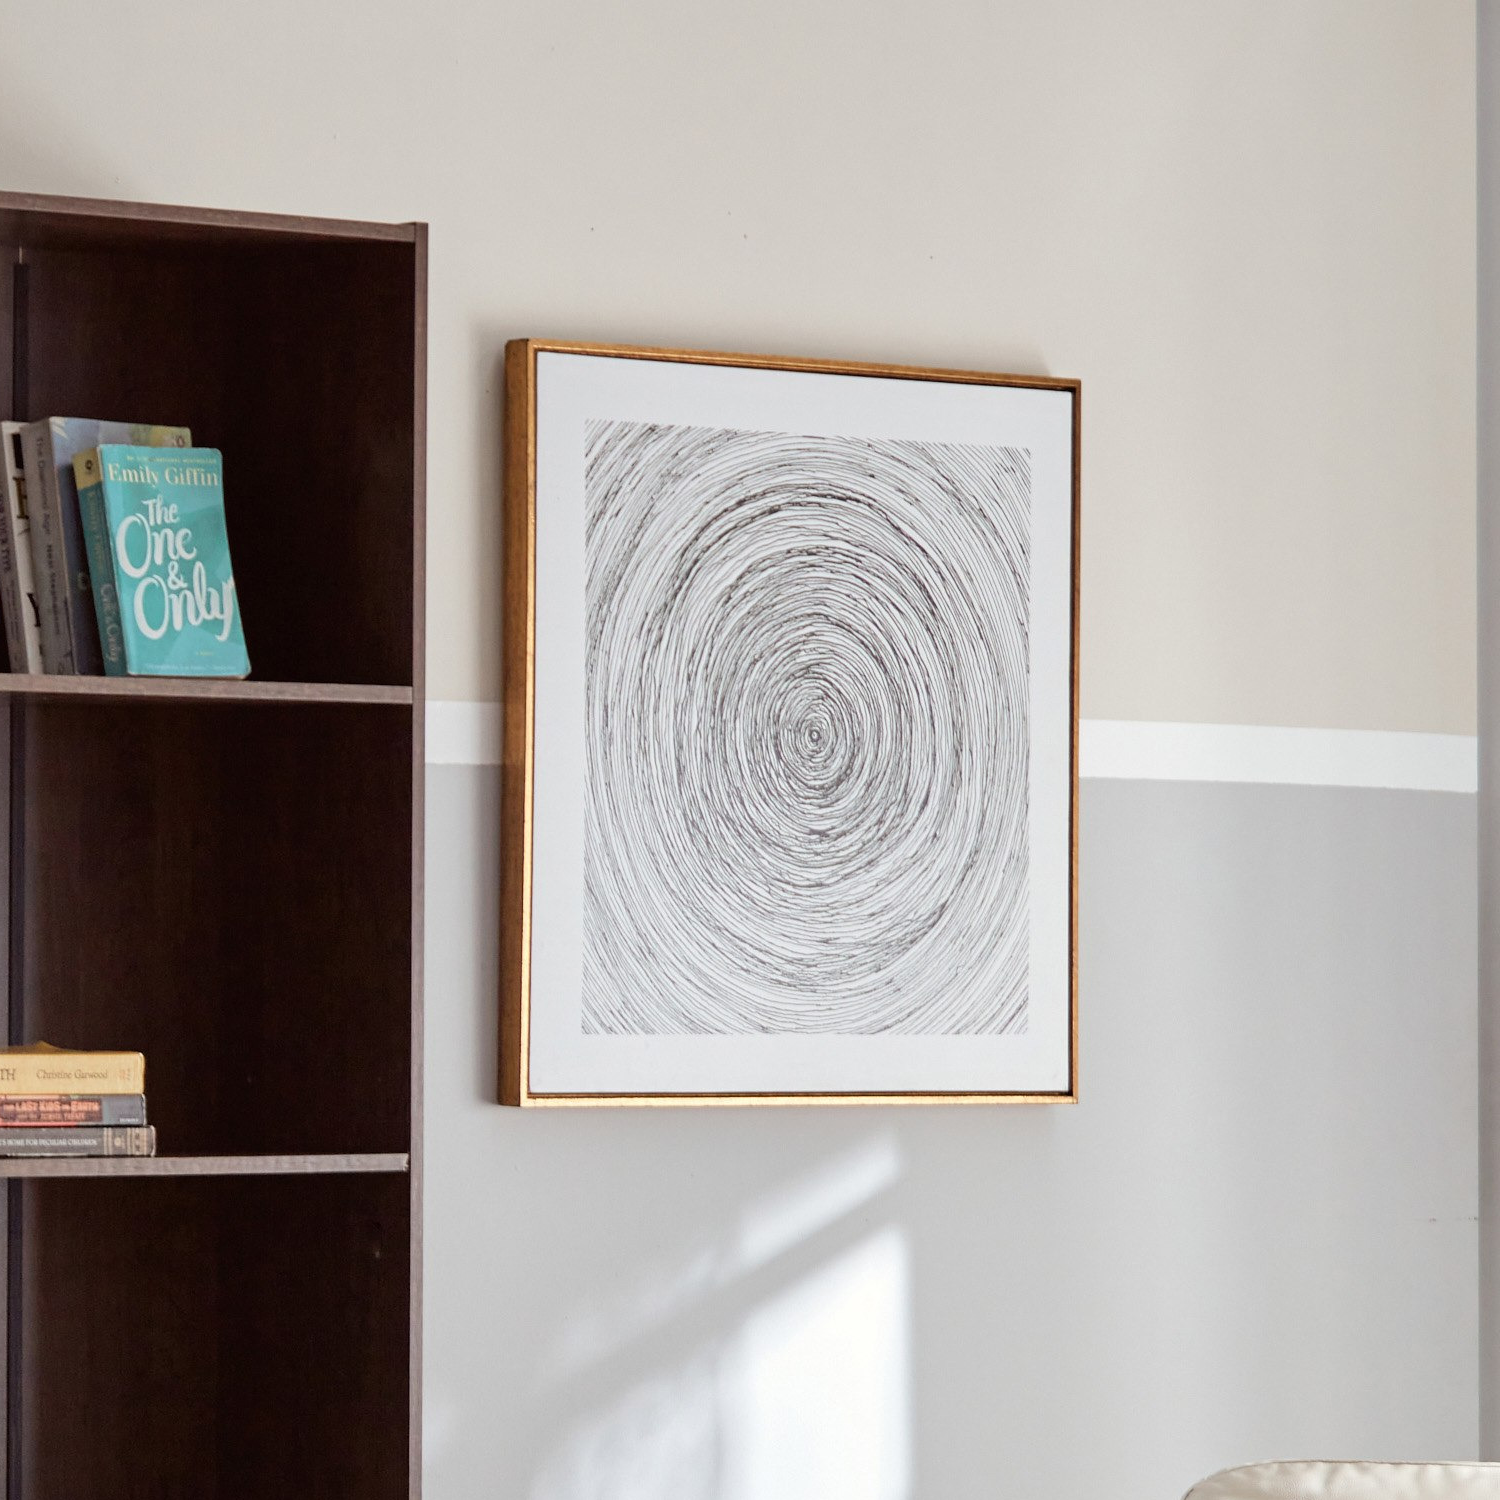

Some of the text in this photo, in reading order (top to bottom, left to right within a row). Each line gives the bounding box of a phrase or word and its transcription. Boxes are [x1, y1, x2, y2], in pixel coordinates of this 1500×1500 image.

[108, 463, 220, 489] Emily Giffin
[142, 494, 180, 525] The
[116, 513, 197, 578] One
[166, 558, 189, 589] &
[134, 561, 235, 641] Only
[35, 1068, 72, 1081] Christine
[73, 1068, 109, 1081] Garwood
